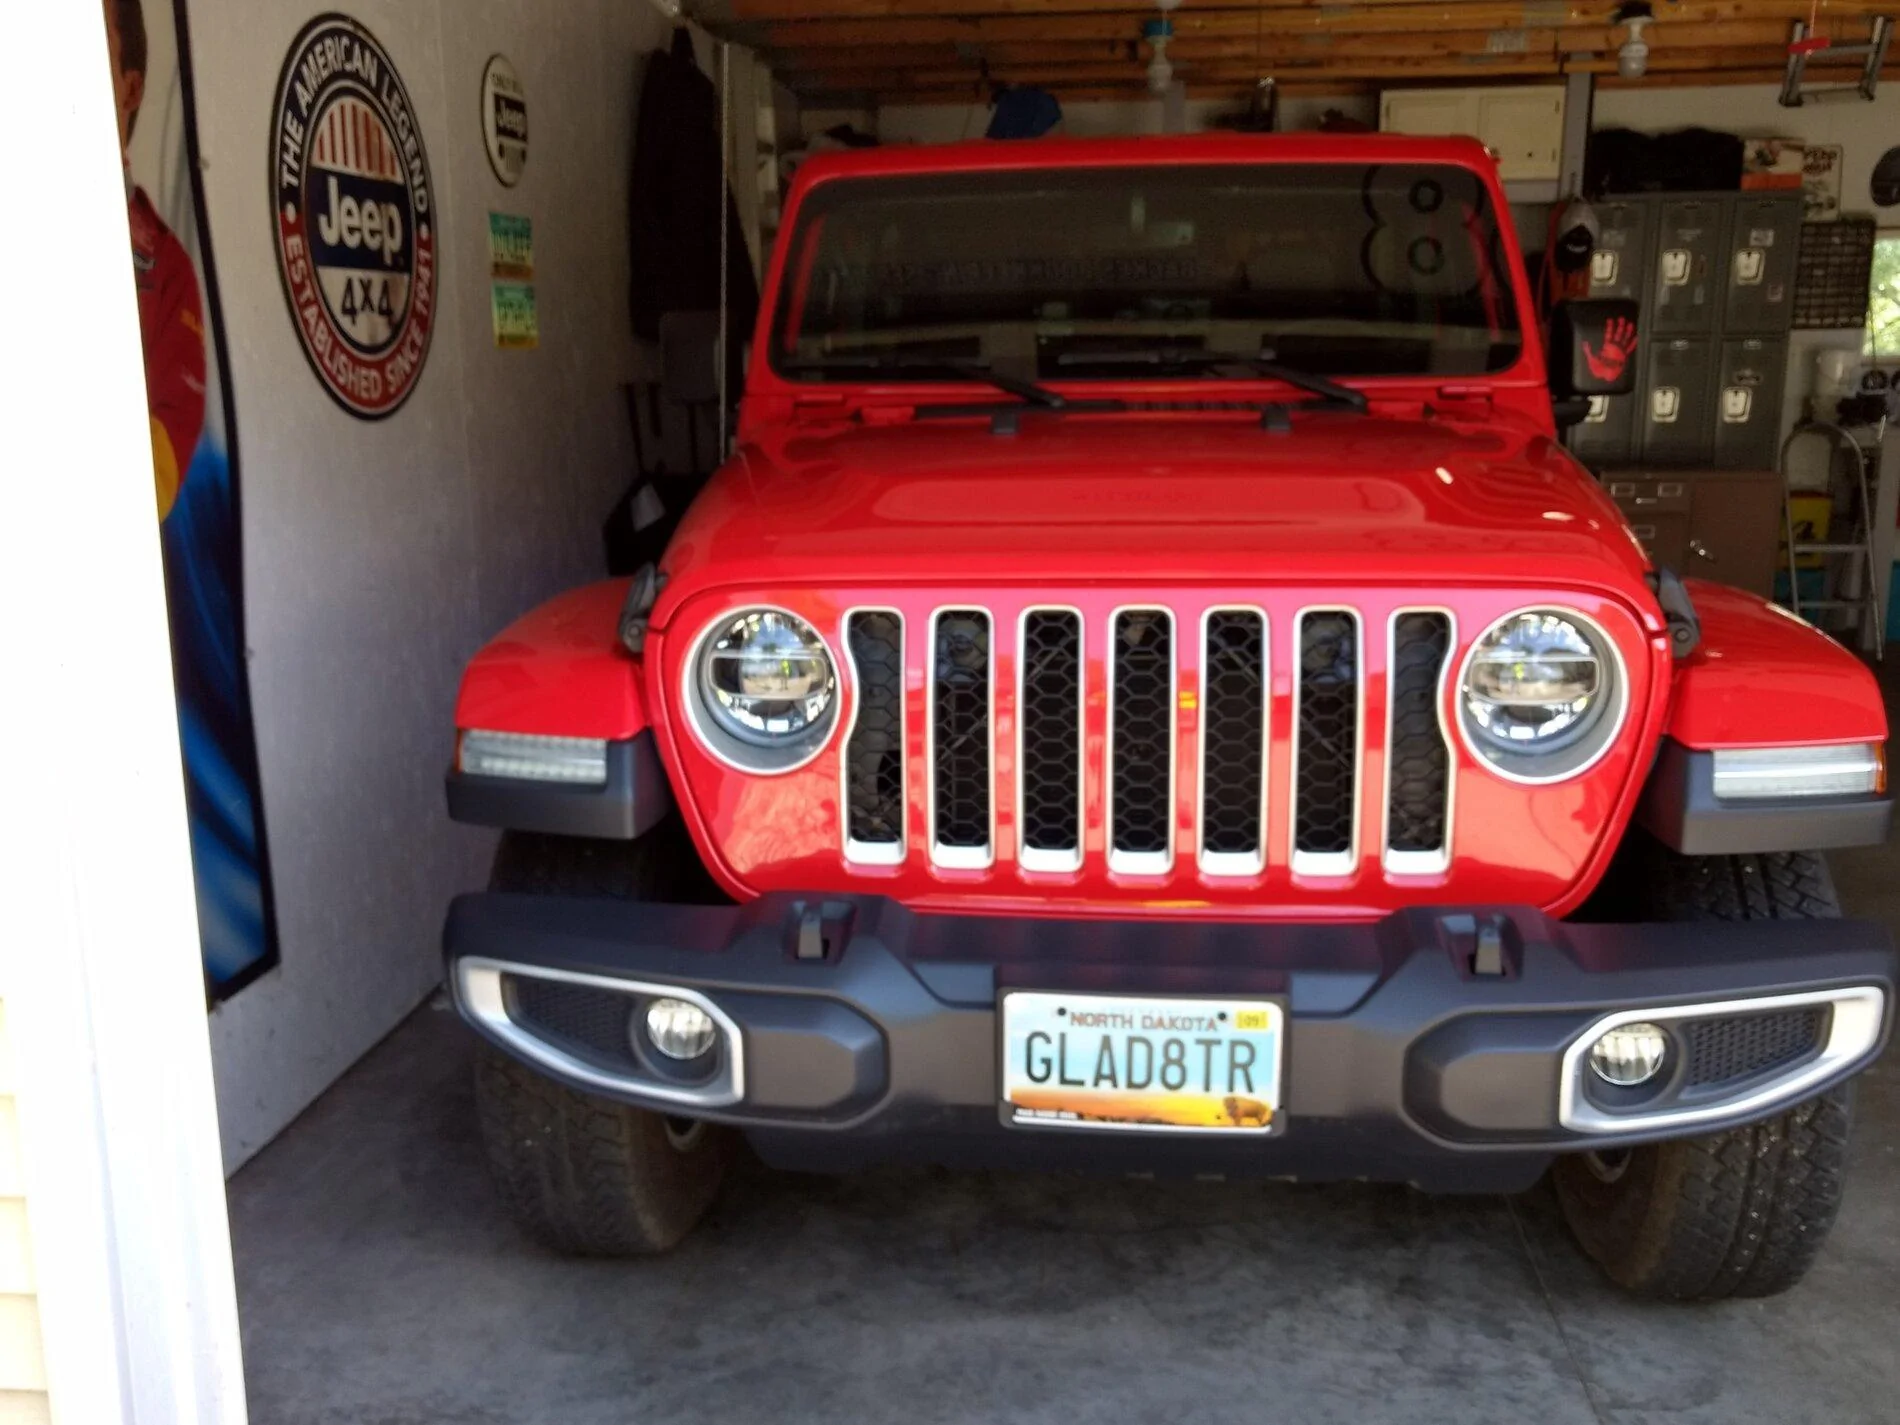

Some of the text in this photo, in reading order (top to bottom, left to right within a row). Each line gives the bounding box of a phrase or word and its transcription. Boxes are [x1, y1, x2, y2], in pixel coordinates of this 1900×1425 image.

[281, 35, 428, 213] THE AMERICAN LEGEND
[318, 175, 403, 267] Jeep
[285, 235, 383, 400] ESTABLISHED
[384, 319, 424, 394] SINCE
[1025, 1031, 1257, 1093] GLAD8TR
[1070, 1011, 1218, 1032] NORTH DAKOTA
